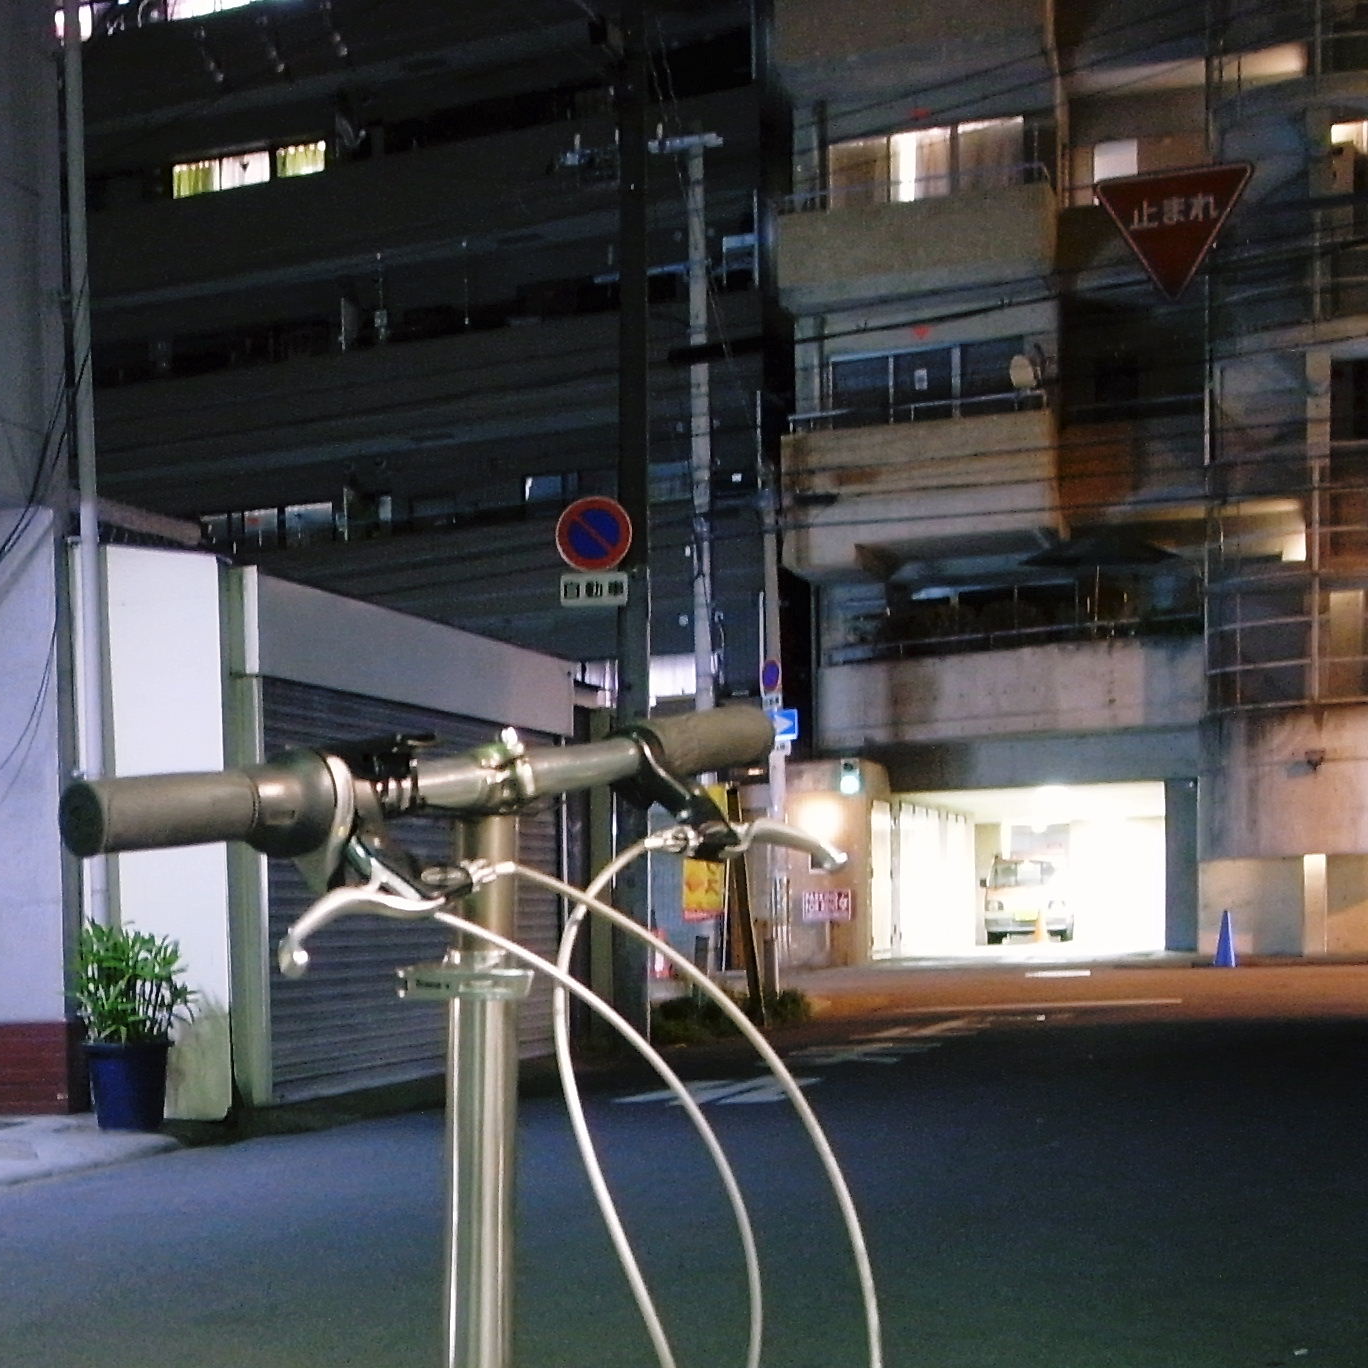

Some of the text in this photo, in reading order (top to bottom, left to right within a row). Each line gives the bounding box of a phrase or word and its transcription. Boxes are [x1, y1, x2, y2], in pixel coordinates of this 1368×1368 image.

[1130, 193, 1220, 230] 止まれ
[563, 580, 624, 599] 自動車
